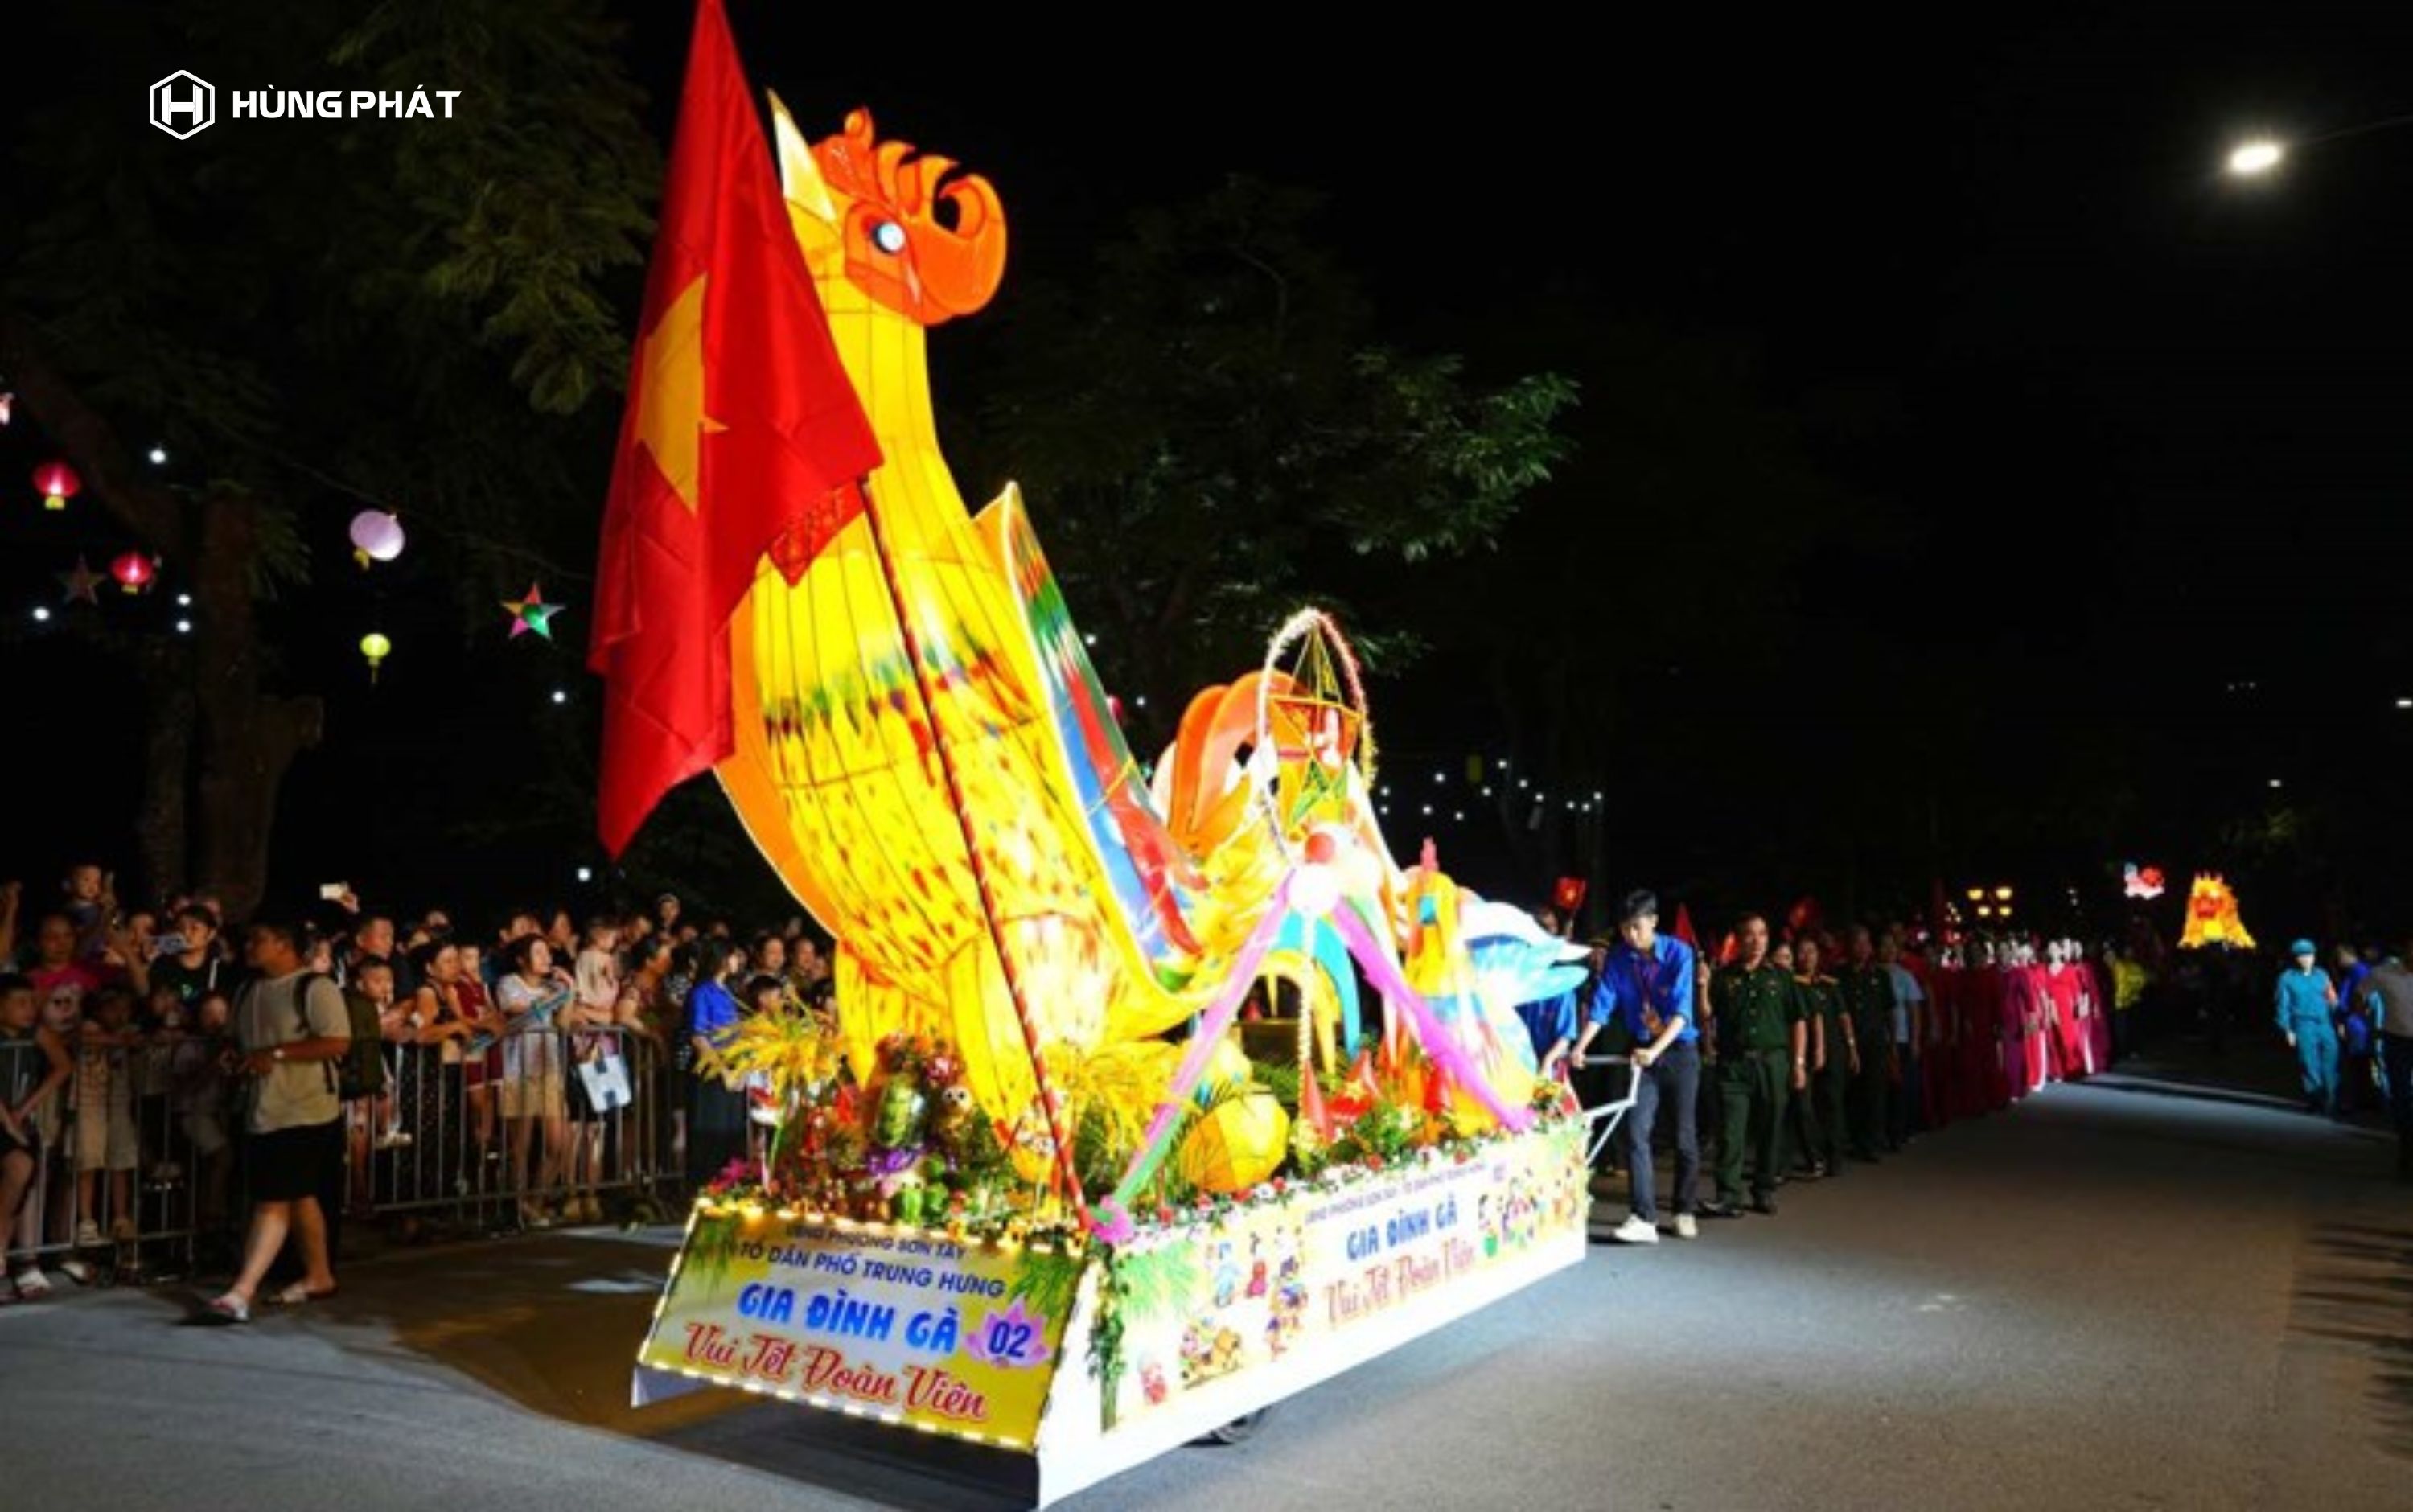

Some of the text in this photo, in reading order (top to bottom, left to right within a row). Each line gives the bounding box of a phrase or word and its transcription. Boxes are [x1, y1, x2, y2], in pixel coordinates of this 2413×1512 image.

[862, 1259, 933, 1287] TRUNG
[738, 1283, 959, 1354] GIA ĐÌNH GÀ
[988, 1320, 1033, 1359] 02
[685, 1321, 985, 1417] Vui Tết Đoàn Viên
